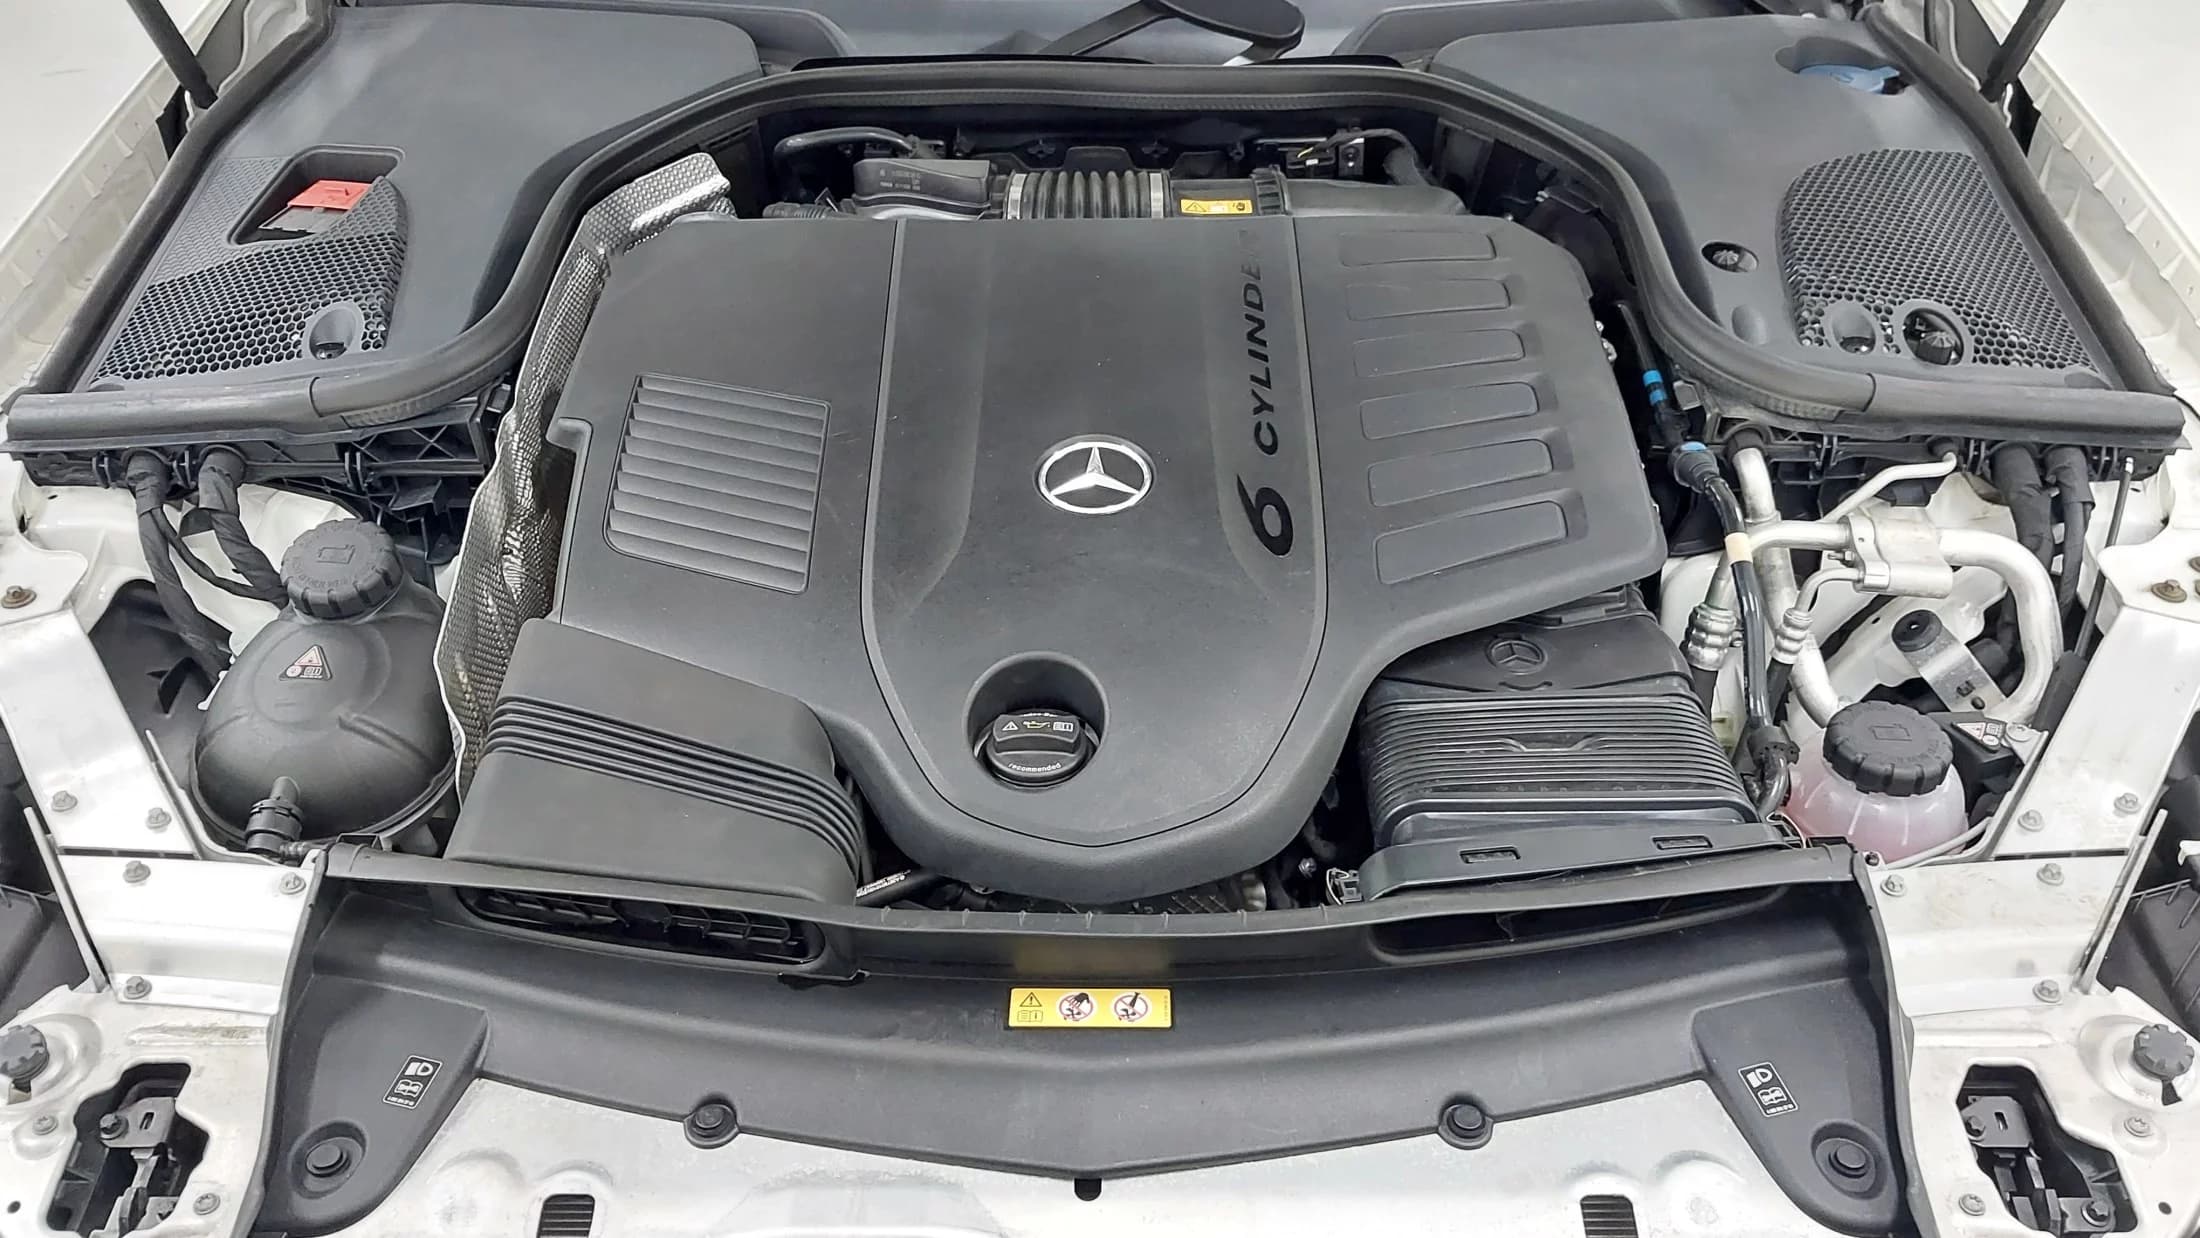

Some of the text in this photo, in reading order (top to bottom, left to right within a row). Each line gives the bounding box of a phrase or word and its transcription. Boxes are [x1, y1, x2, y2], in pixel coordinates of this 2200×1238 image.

[1236, 232, 1295, 557] 6 CYLINDE
[1008, 762, 1062, 773] recommended
